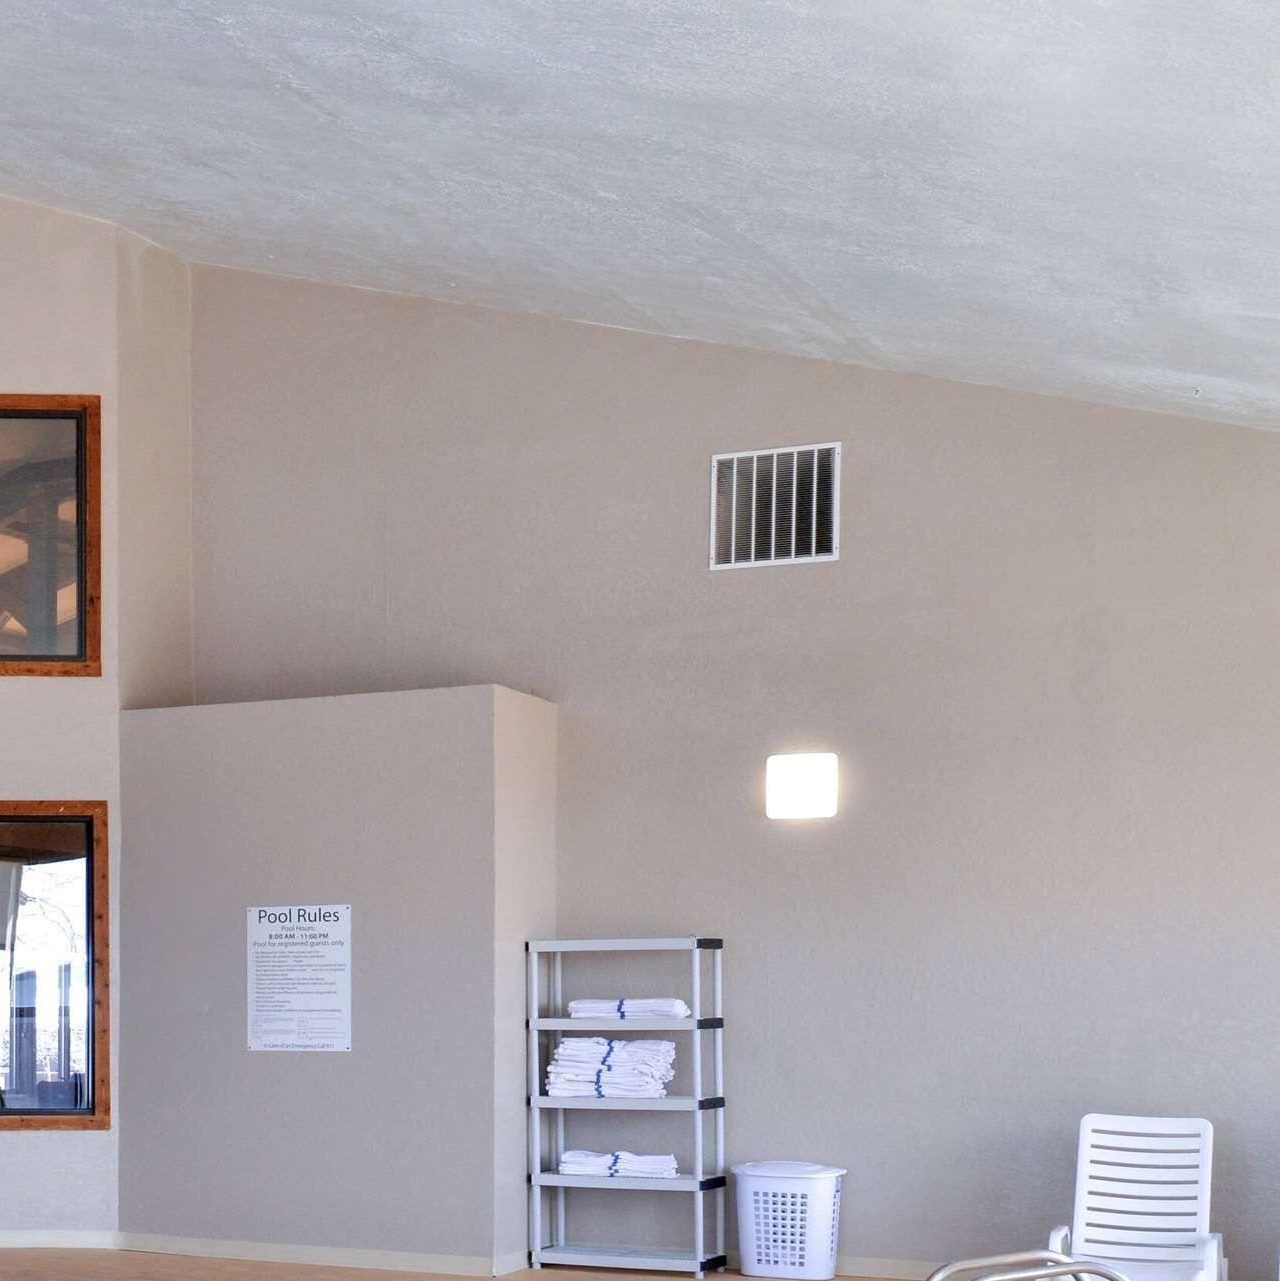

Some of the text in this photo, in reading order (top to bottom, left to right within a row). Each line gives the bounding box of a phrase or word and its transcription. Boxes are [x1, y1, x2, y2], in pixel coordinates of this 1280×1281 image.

[258, 907, 340, 924] Pool Rules
[278, 940, 308, 948] registered
